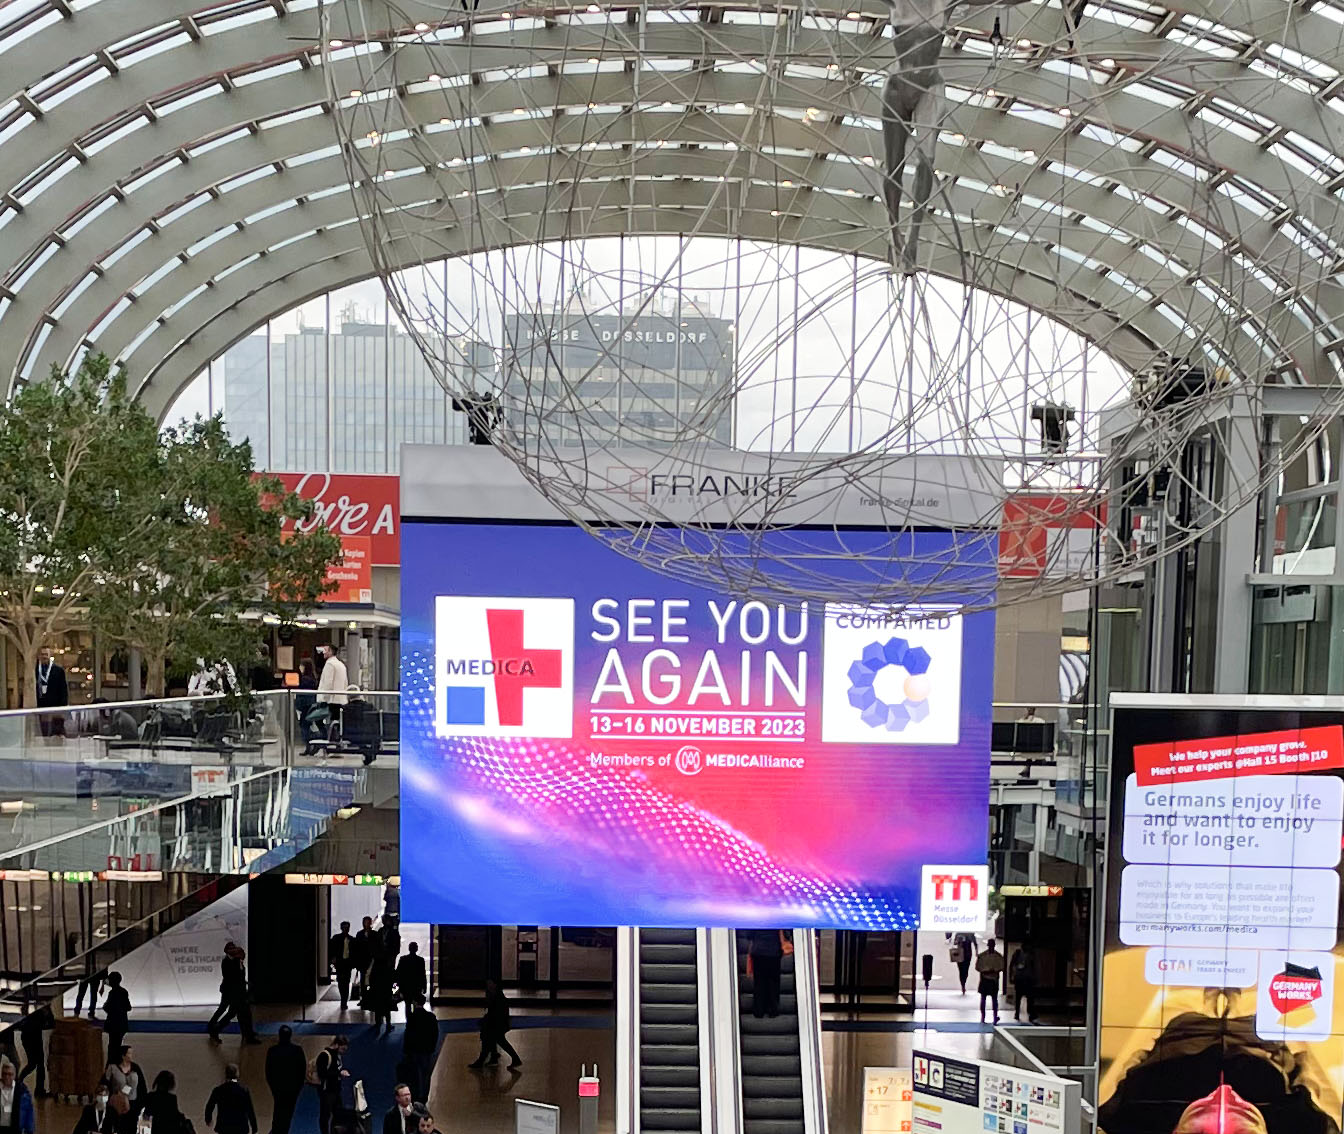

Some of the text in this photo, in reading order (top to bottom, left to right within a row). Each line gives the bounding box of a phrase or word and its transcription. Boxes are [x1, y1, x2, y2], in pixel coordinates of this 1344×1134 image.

[651, 475, 797, 497] FRANKE
[591, 599, 808, 645] SEE YOU
[446, 658, 535, 677] MEDICA
[590, 648, 807, 706] AGAIN
[651, 716, 757, 735] NOVEMBER
[761, 718, 806, 736] 2023
[590, 752, 655, 767] Members
[658, 752, 671, 766] of
[1169, 751, 1186, 762] We
[1210, 748, 1232, 759] your
[1234, 742, 1278, 757] company
[1151, 766, 1177, 777] Meet
[1178, 764, 1195, 775] our
[1196, 760, 1233, 773] experts
[1265, 755, 1277, 766] 15
[1279, 752, 1309, 764] Booth
[1145, 791, 1322, 812] Germans enjoy life
[1143, 811, 1315, 833] and want to enjoy
[1142, 830, 1259, 850] it for longer.
[170, 946, 199, 954] WHERE
[175, 955, 224, 964] HEALTHCAR
[1272, 981, 1319, 991] GERMANY
[1277, 989, 1315, 1000] WORKS.
